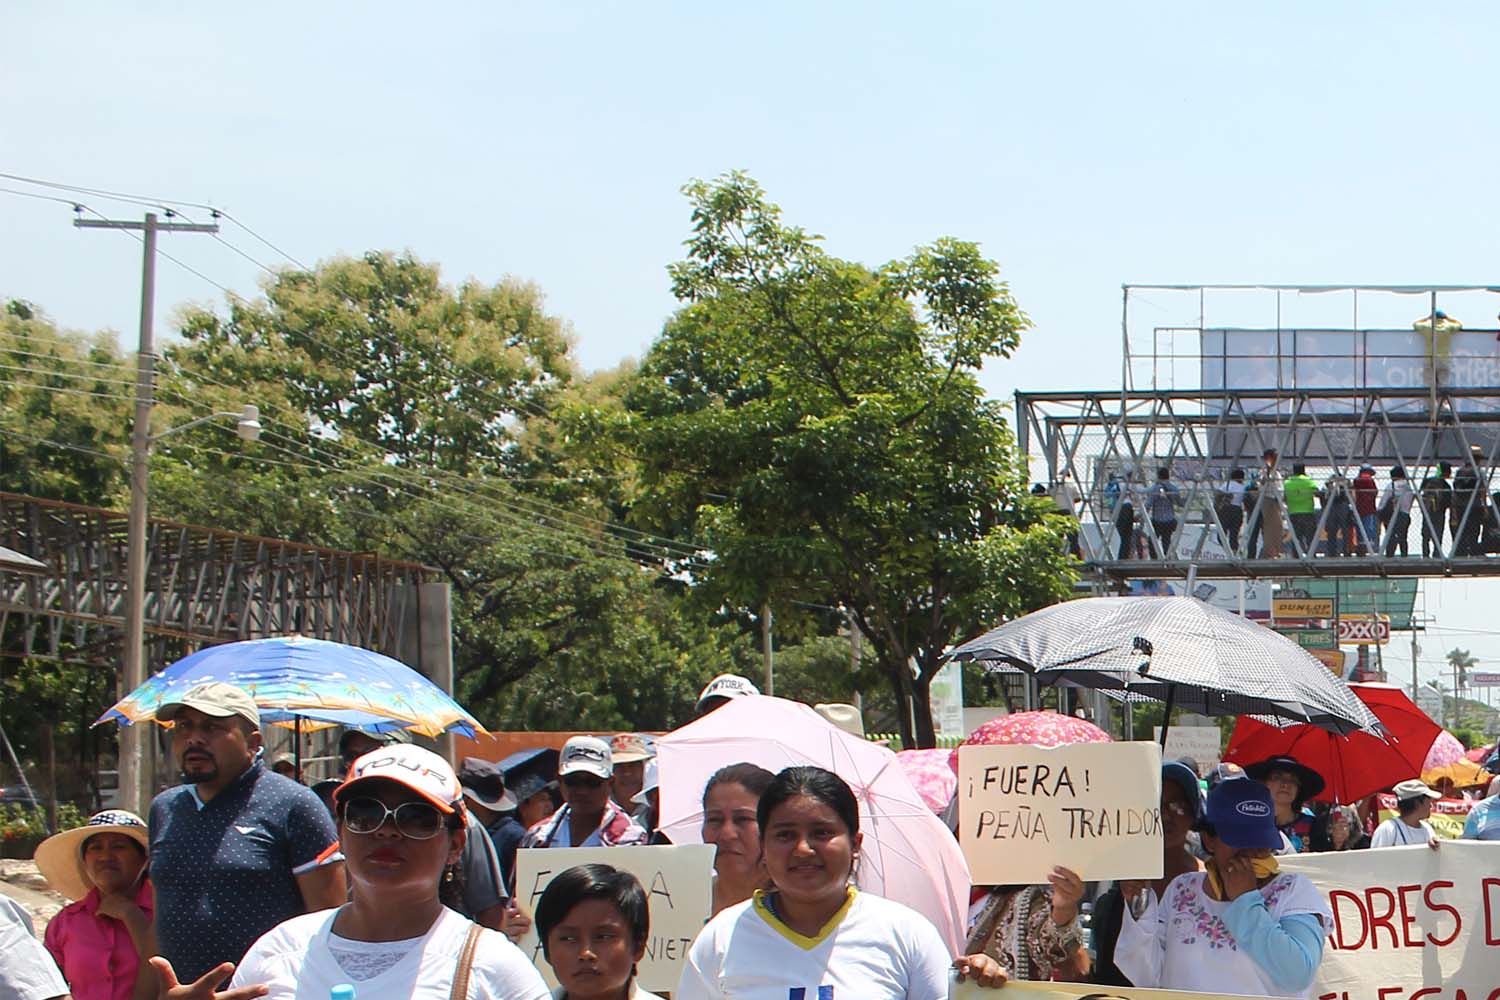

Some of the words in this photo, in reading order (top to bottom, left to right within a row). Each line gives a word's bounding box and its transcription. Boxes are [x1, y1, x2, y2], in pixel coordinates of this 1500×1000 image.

[1338, 621, 1387, 639] OXXO
[968, 764, 1092, 798] ¡FUERA!
[976, 805, 1050, 843] PEÑA
[1062, 807, 1163, 840] TRAIDOR
[1328, 880, 1463, 951] DRES
